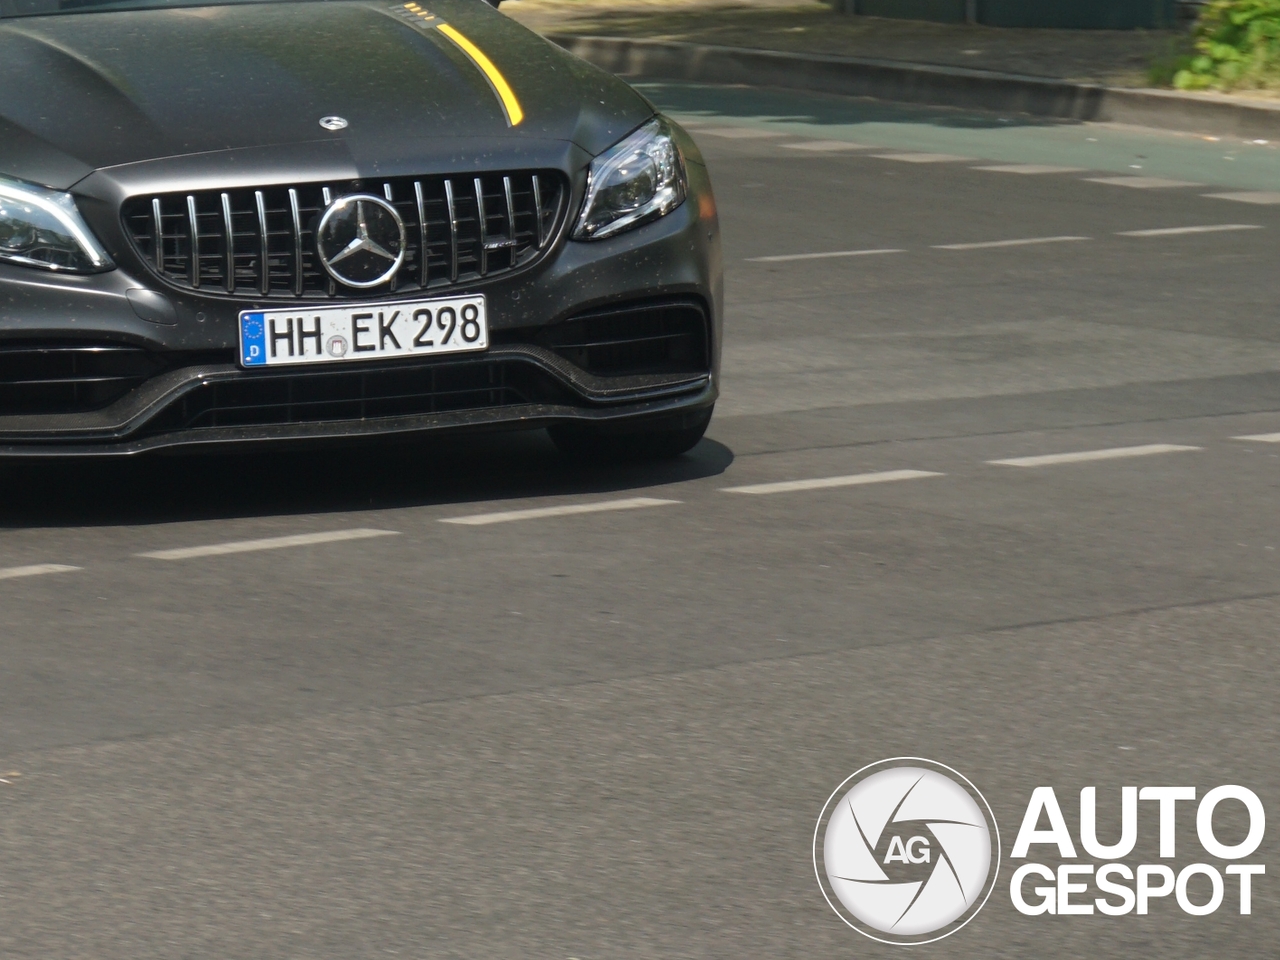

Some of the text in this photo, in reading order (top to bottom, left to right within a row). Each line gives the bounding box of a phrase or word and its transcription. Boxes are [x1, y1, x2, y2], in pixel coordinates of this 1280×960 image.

[269, 303, 481, 358] HH EK 298
[249, 345, 260, 357] D
